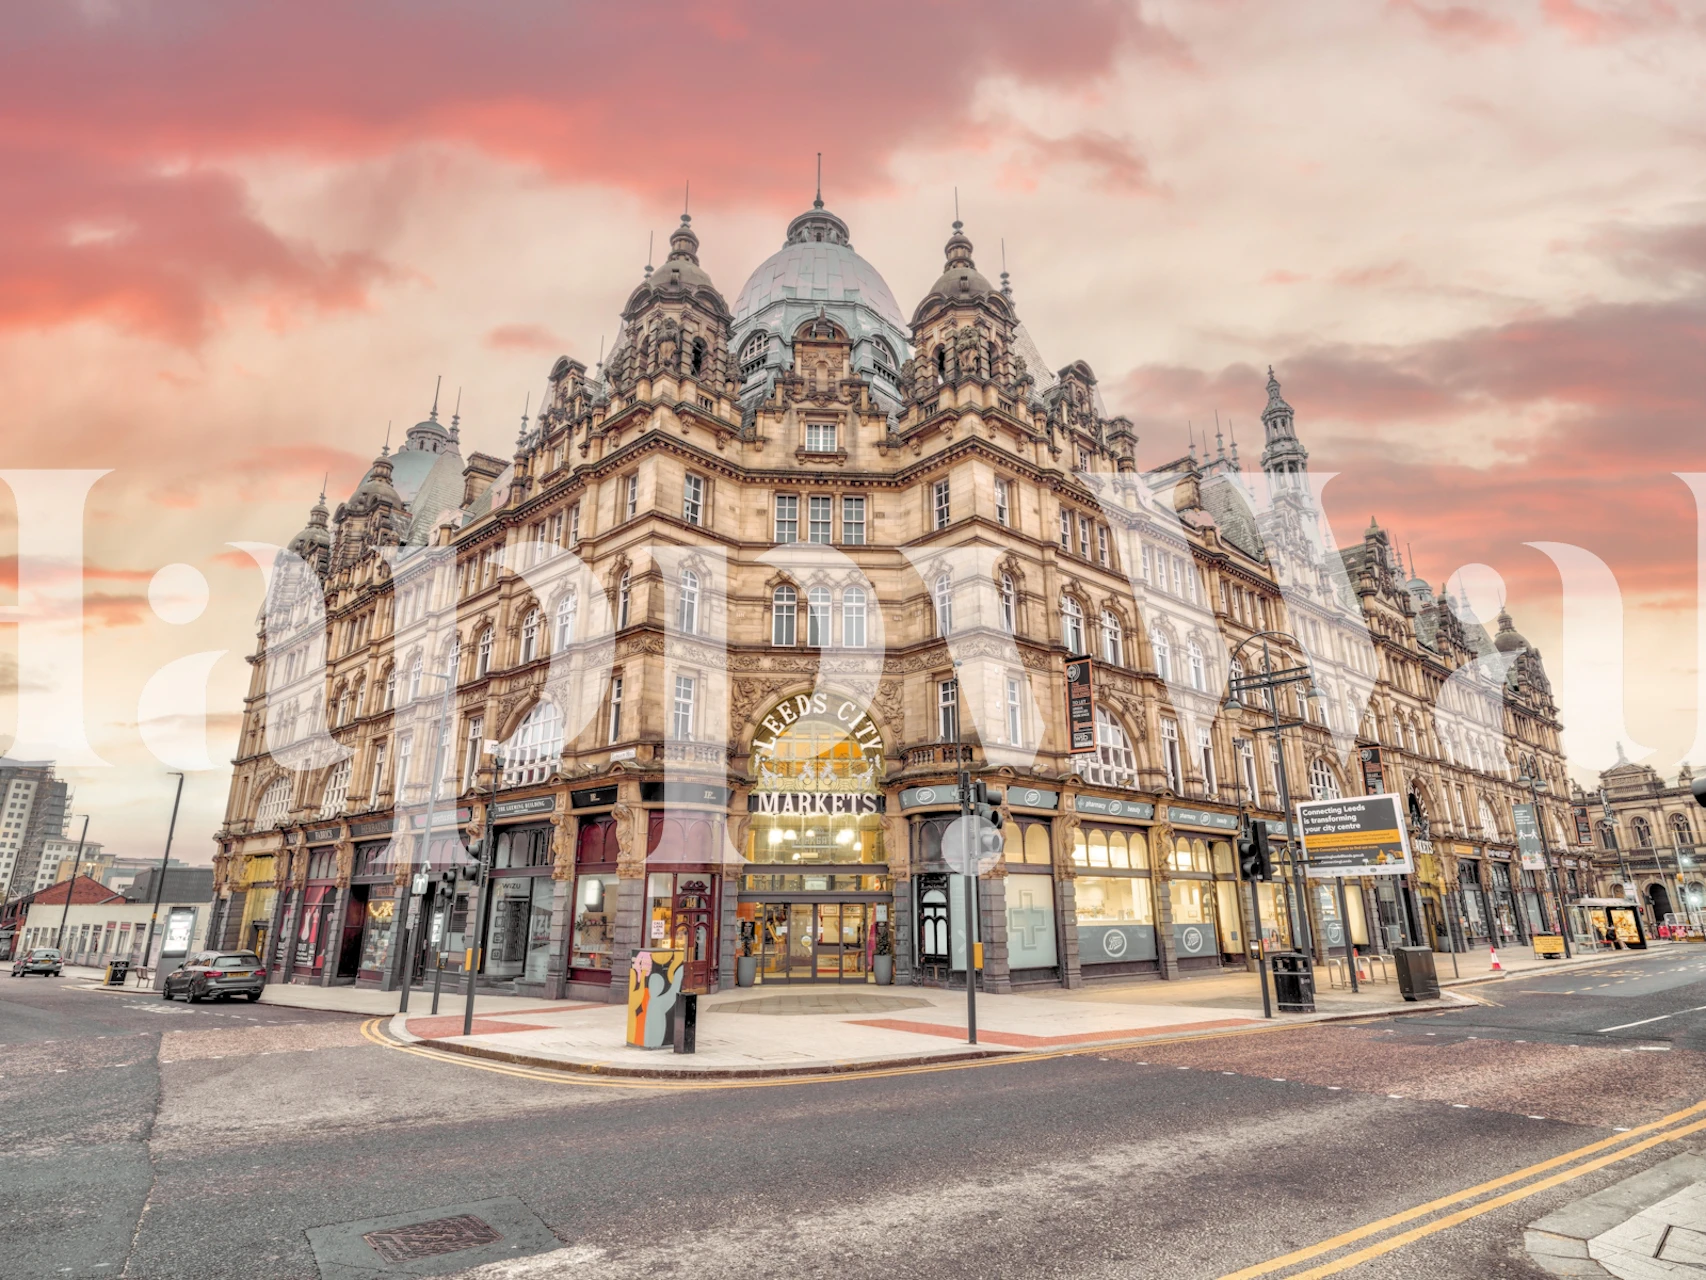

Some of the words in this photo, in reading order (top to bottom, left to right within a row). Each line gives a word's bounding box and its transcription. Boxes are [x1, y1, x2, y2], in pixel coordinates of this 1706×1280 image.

[752, 693, 828, 751] LEEDS
[837, 700, 883, 751] CITY
[525, 801, 545, 809] BUILDING
[757, 791, 877, 814] MARKETS
[1085, 801, 1106, 810] pharmacy
[1127, 805, 1141, 814] beauty
[1179, 811, 1196, 820] pharmacy
[1302, 806, 1342, 816] Connecting
[1343, 804, 1365, 812] Leeds
[1311, 815, 1357, 824] transforming
[315, 829, 333, 840] FABRICS
[1304, 826, 1321, 834] your
[1322, 824, 1336, 832] city
